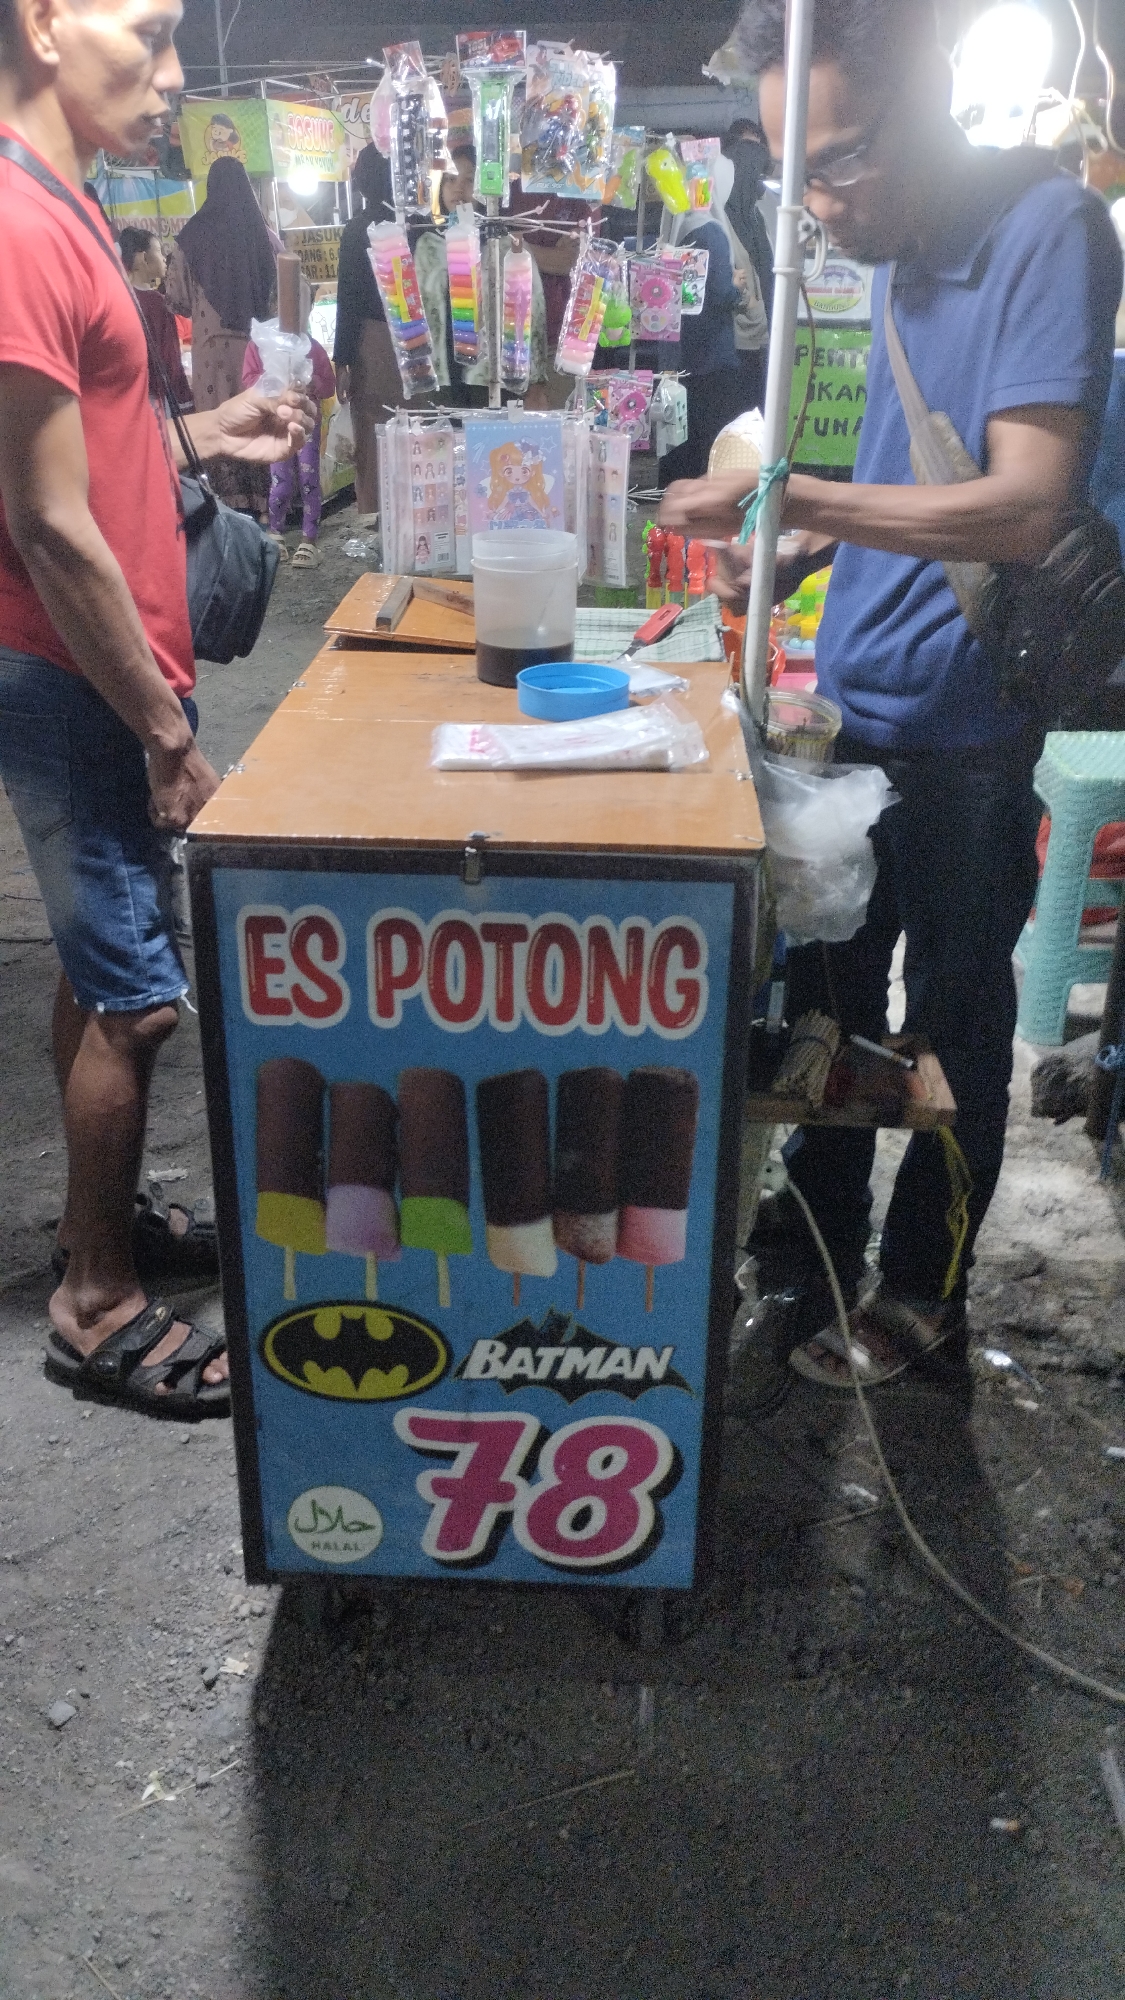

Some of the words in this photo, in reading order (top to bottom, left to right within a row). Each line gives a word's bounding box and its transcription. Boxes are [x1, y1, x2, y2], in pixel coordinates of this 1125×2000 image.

[287, 112, 336, 154] JASUKE
[301, 228, 341, 243] JASUK
[793, 344, 868, 369] PENT
[239, 906, 349, 1024] ES
[370, 908, 706, 1038] POTONG
[461, 1338, 675, 1380] BATMAN
[396, 1409, 672, 1566] 78
[311, 1541, 361, 1551] HALAL
